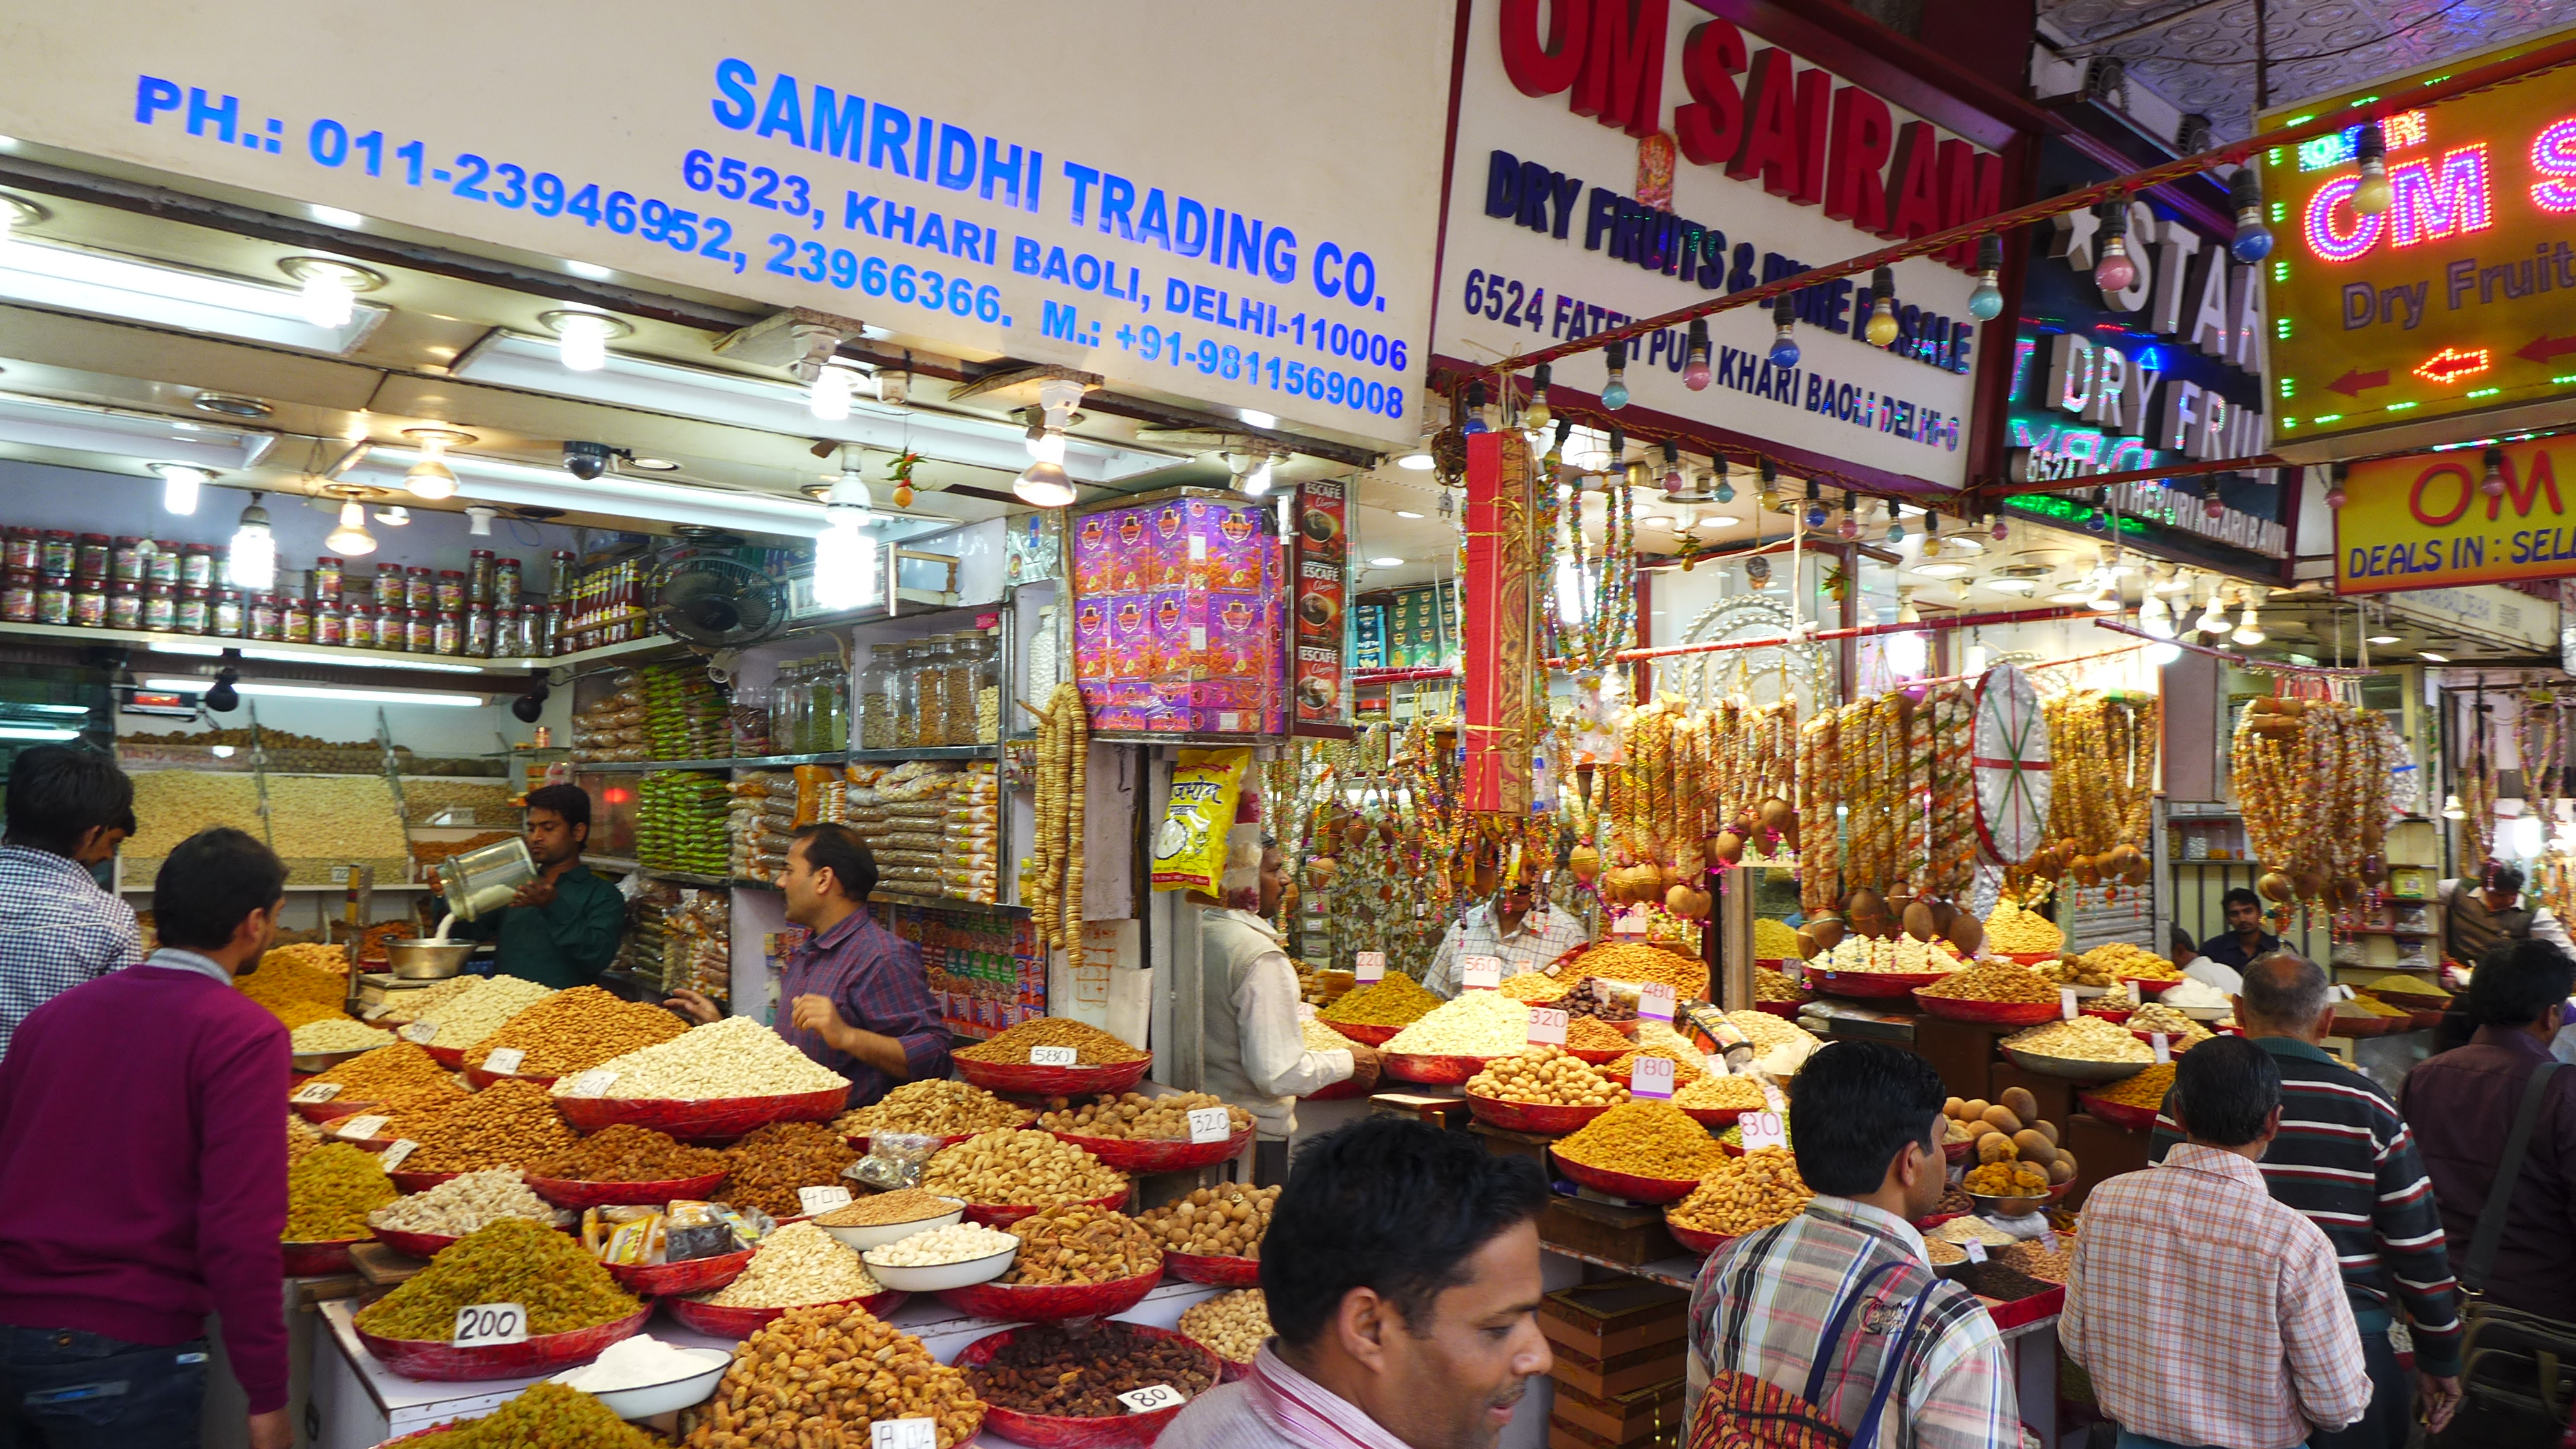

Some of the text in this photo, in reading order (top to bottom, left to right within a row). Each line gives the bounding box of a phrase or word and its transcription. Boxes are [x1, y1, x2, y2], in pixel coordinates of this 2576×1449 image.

[1499, 0, 2002, 277] OM SAIRAM
[711, 56, 1386, 311] SAMRIDHI TRADING CO.
[134, 75, 1404, 421] PH.: 011-23946952, 23966366. M.: +91-9811569008
[684, 149, 1407, 373] 6523, KHARI BAOLI, DELHI-110006
[1485, 149, 1583, 240] DRY
[1585, 187, 1727, 290] FRUITS
[1727, 242, 1756, 295] &
[1852, 287, 1973, 375] SALE
[2342, 281, 2429, 330] Dry
[1465, 269, 1544, 332] 6524
[1648, 327, 1713, 373] PUI
[1718, 345, 1800, 406] KHARI
[1805, 373, 1875, 427] BAOLI
[1881, 395, 1959, 452] DELHI-6
[2055, 332, 2161, 436] DRY
[1304, 482, 1342, 500] ESCAFÉ
[2409, 450, 2564, 526] OM
[2349, 539, 2442, 578] DEALS
[2453, 536, 2483, 569] IN
[1300, 563, 1340, 582] ESCAFÉ
[1298, 648, 1337, 663] ESCAFÉ
[1357, 952, 1383, 966] 220
[1465, 958, 1499, 972] 560
[1643, 982, 1676, 1000] 480
[1530, 1009, 1567, 1028] 320
[1034, 1050, 1070, 1063] 580
[1635, 1059, 1672, 1077] 180
[573, 1079, 608, 1097] 540
[1192, 1112, 1228, 1133] 320
[1741, 1112, 1780, 1137] 80
[804, 1189, 848, 1206] 400
[458, 1308, 517, 1341] 200
[1130, 1388, 1167, 1407] 80
